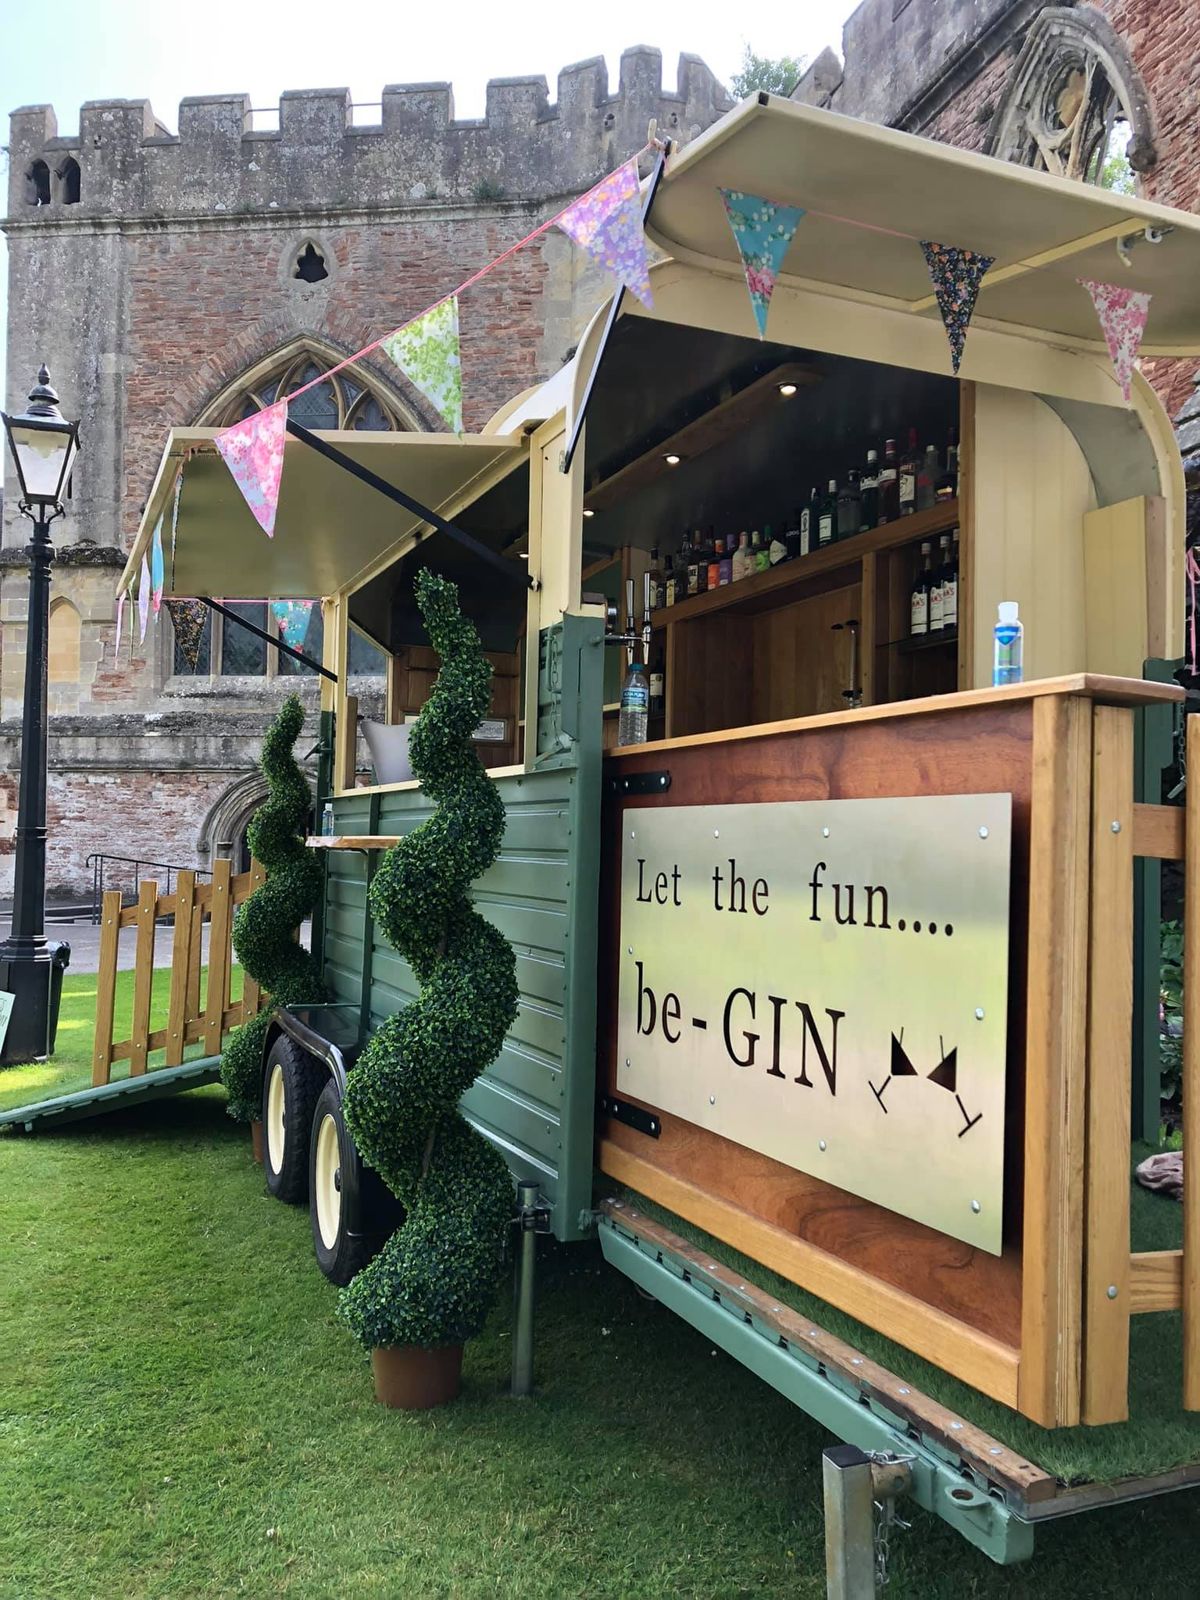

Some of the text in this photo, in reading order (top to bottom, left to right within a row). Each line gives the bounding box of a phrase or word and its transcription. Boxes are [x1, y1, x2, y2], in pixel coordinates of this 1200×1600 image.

[636, 858, 954, 937] Let the fun....
[635, 960, 846, 1097] be-GIN
